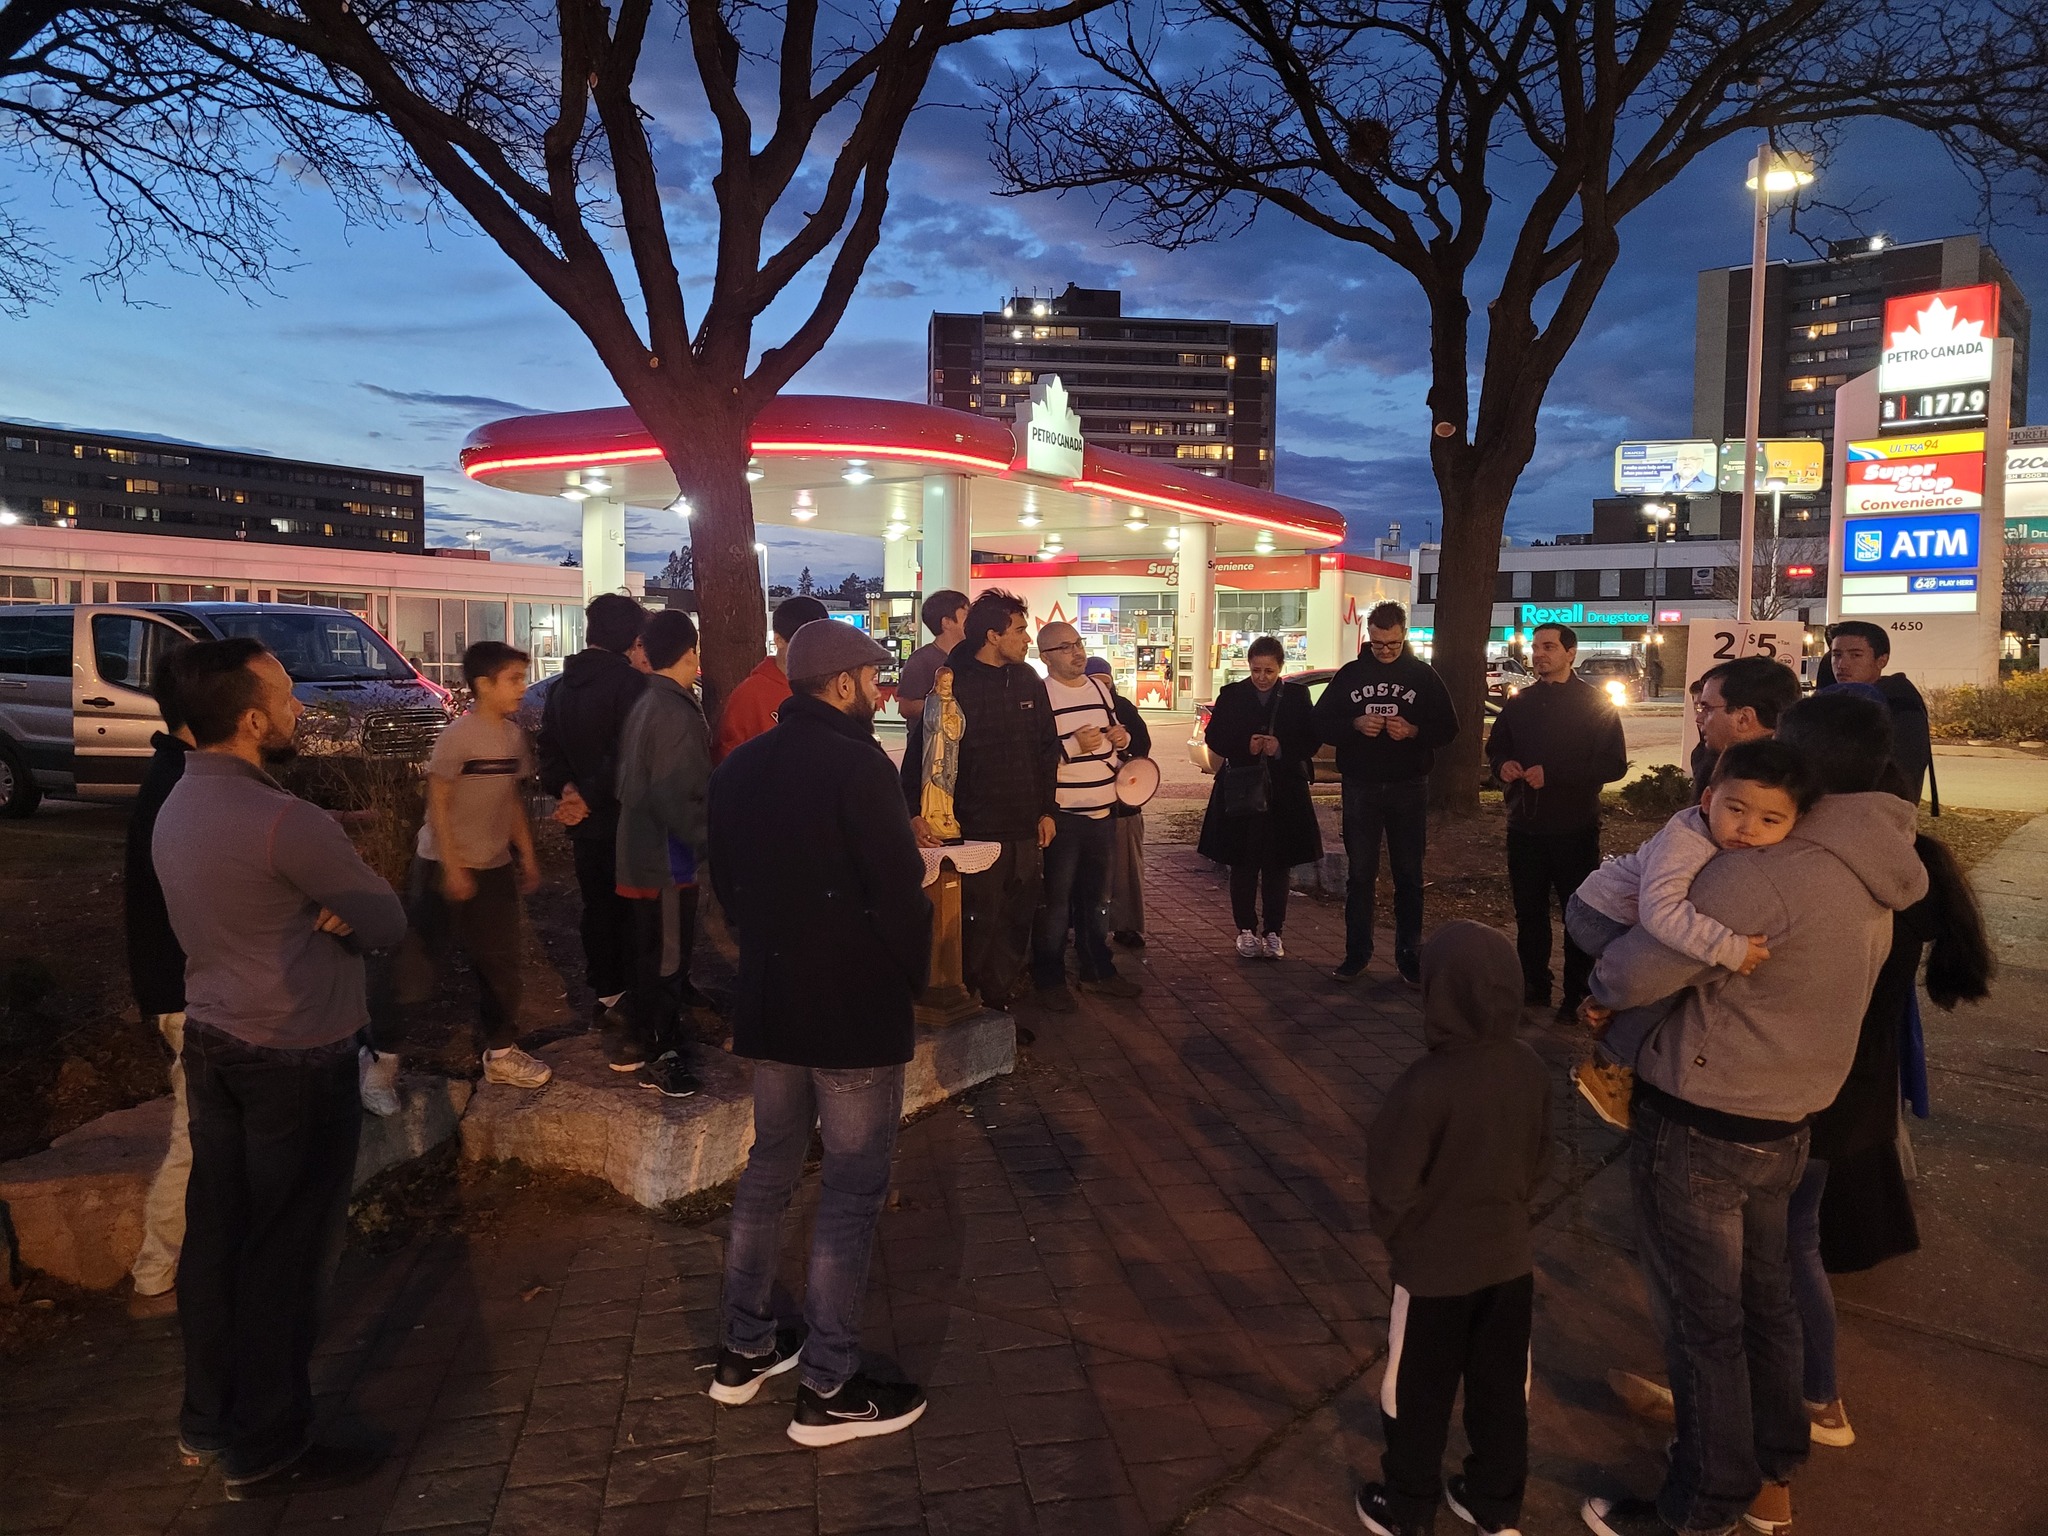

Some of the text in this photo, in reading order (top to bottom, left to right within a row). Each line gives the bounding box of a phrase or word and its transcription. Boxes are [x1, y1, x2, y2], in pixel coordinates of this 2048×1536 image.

[2007, 430, 2048, 440] HOREH
[1862, 463, 1938, 482] Super
[1895, 477, 1954, 494] Stop
[1860, 495, 1964, 511] Convenience
[1889, 528, 1969, 559] ATM
[1521, 603, 1583, 625] Rexall
[1586, 611, 1649, 624] Drugstore
[1890, 621, 1924, 631] 4650
